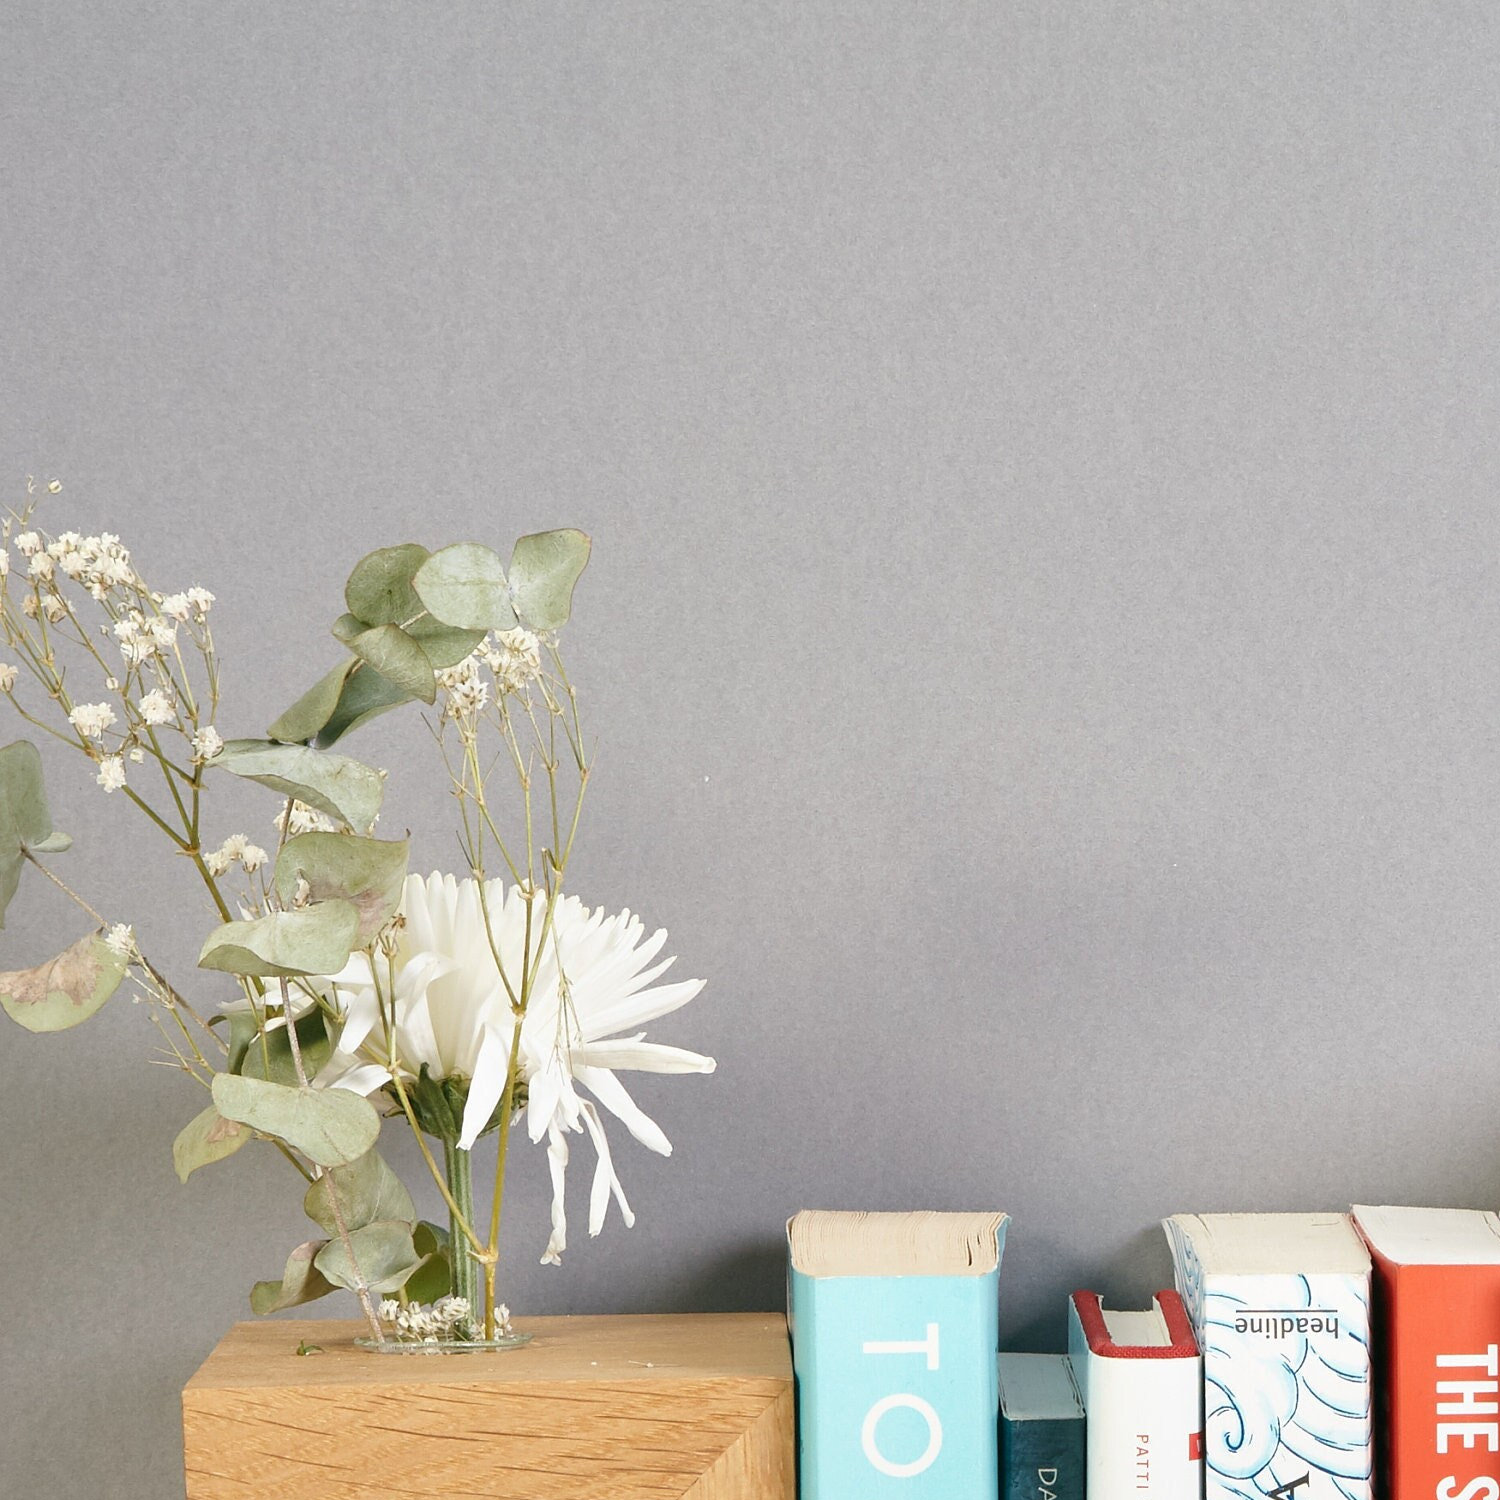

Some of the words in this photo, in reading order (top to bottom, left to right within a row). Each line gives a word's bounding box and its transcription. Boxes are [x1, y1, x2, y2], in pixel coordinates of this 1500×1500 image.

[1235, 1314, 1339, 1339] headline
[1435, 1344, 1499, 1454] THE
[1136, 1434, 1149, 1490] PATTI
